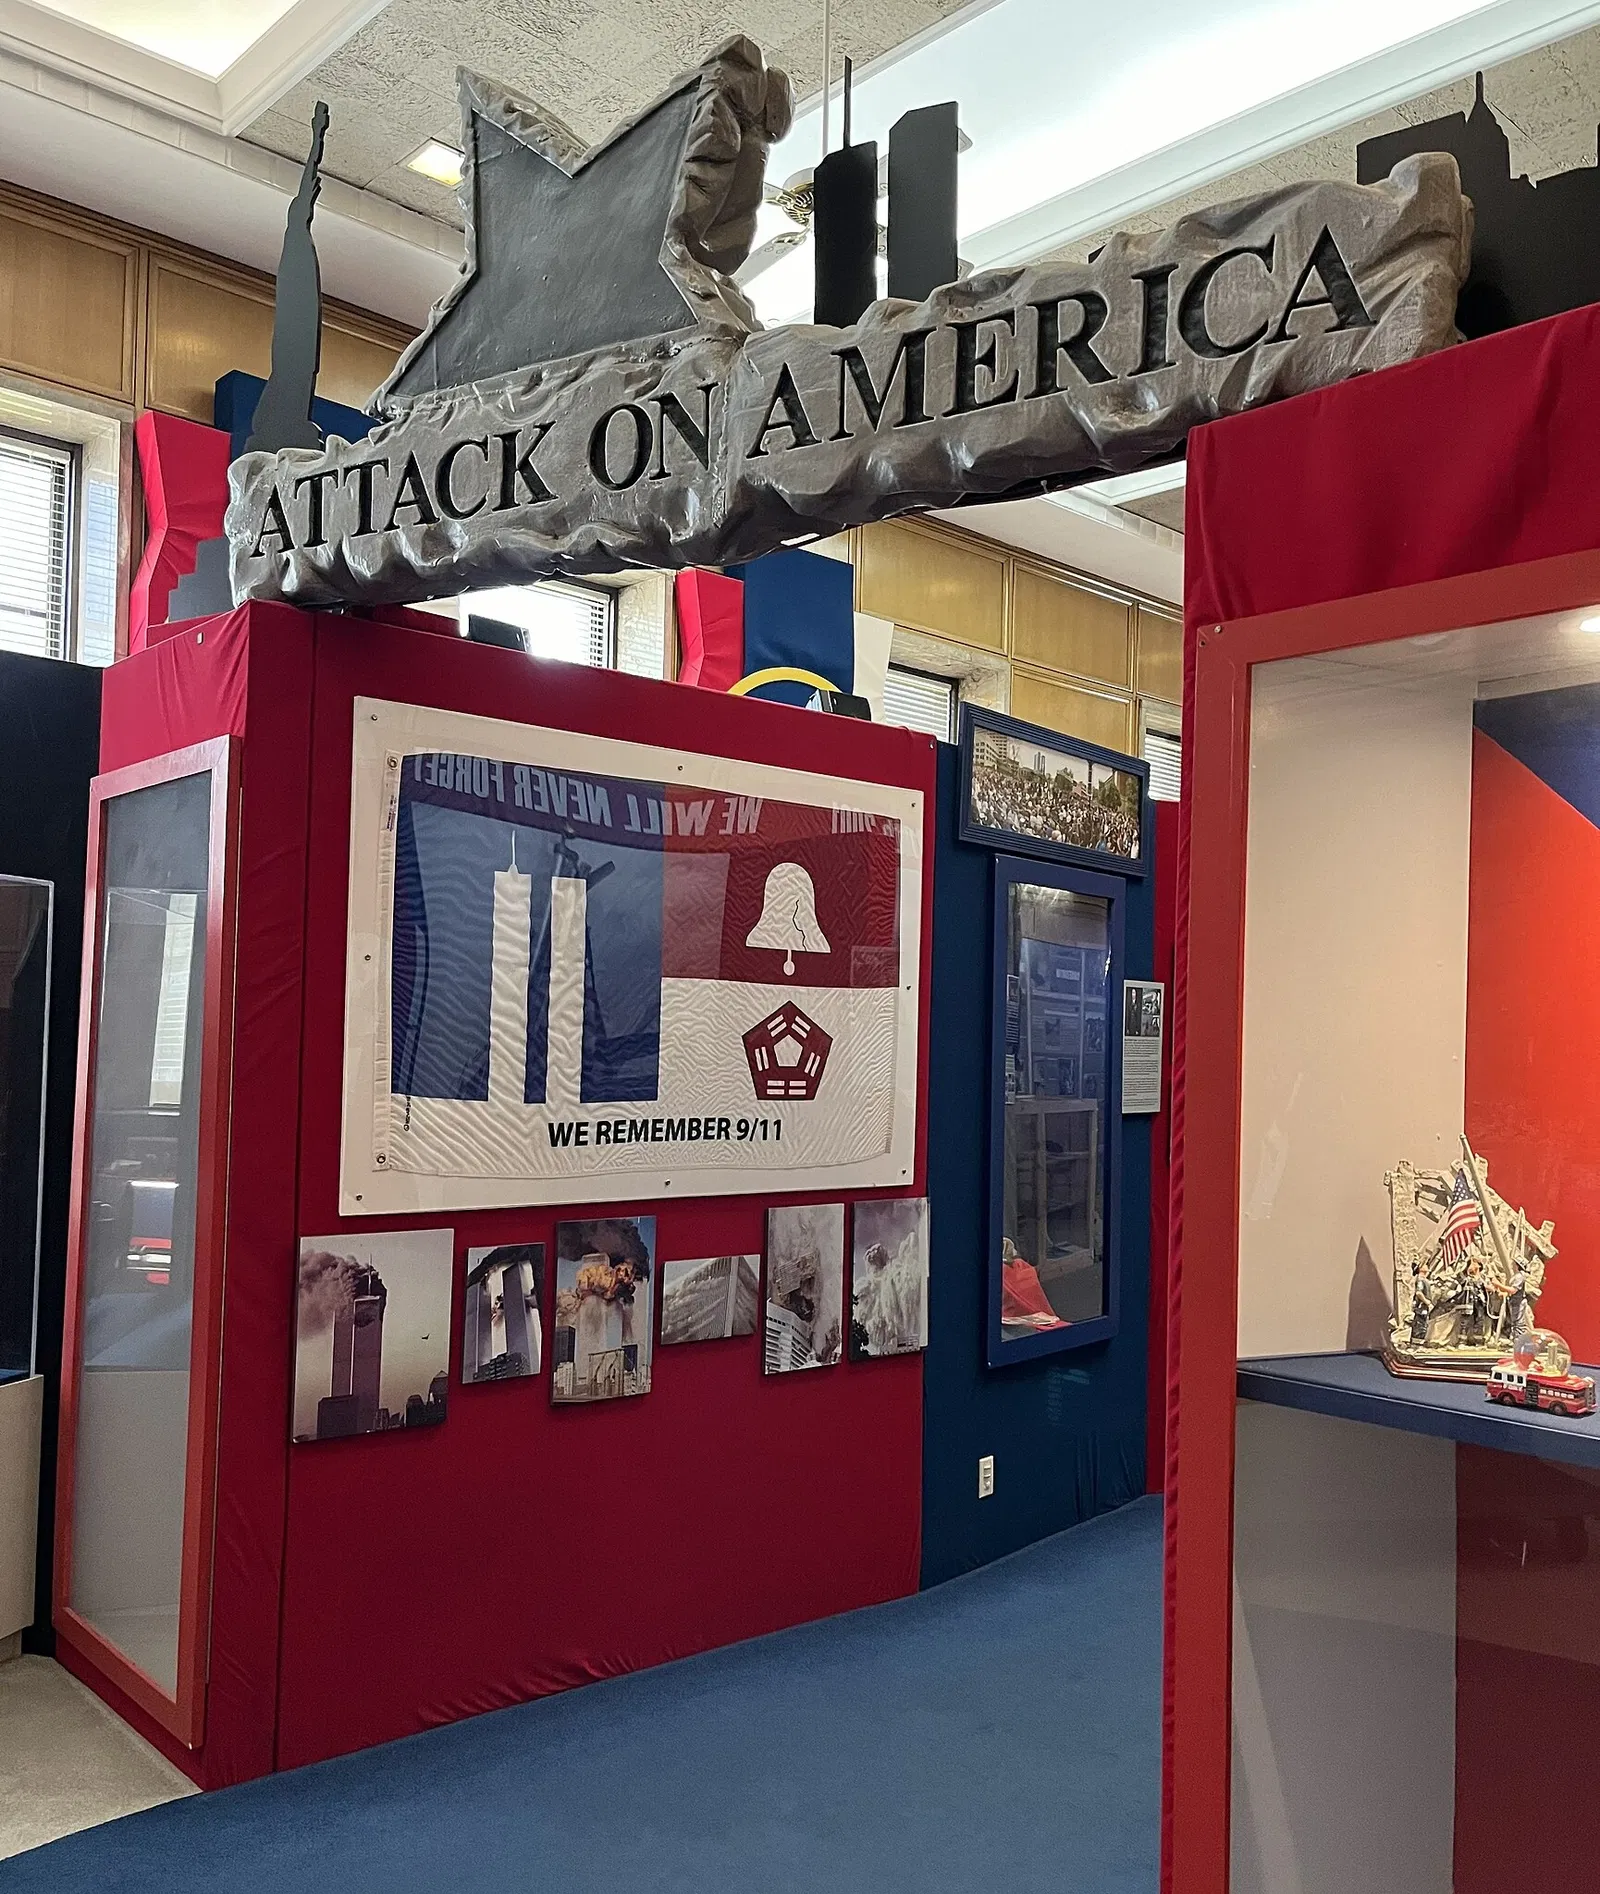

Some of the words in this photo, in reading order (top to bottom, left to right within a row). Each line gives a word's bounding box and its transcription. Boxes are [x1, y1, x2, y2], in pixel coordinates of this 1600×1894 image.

[249, 420, 559, 559] ATTACK
[587, 376, 719, 491] ON
[746, 224, 1377, 459] AMERICA
[548, 1121, 589, 1147] WE
[596, 1117, 731, 1145] REMEMBER
[736, 1117, 782, 1142] 9/11
